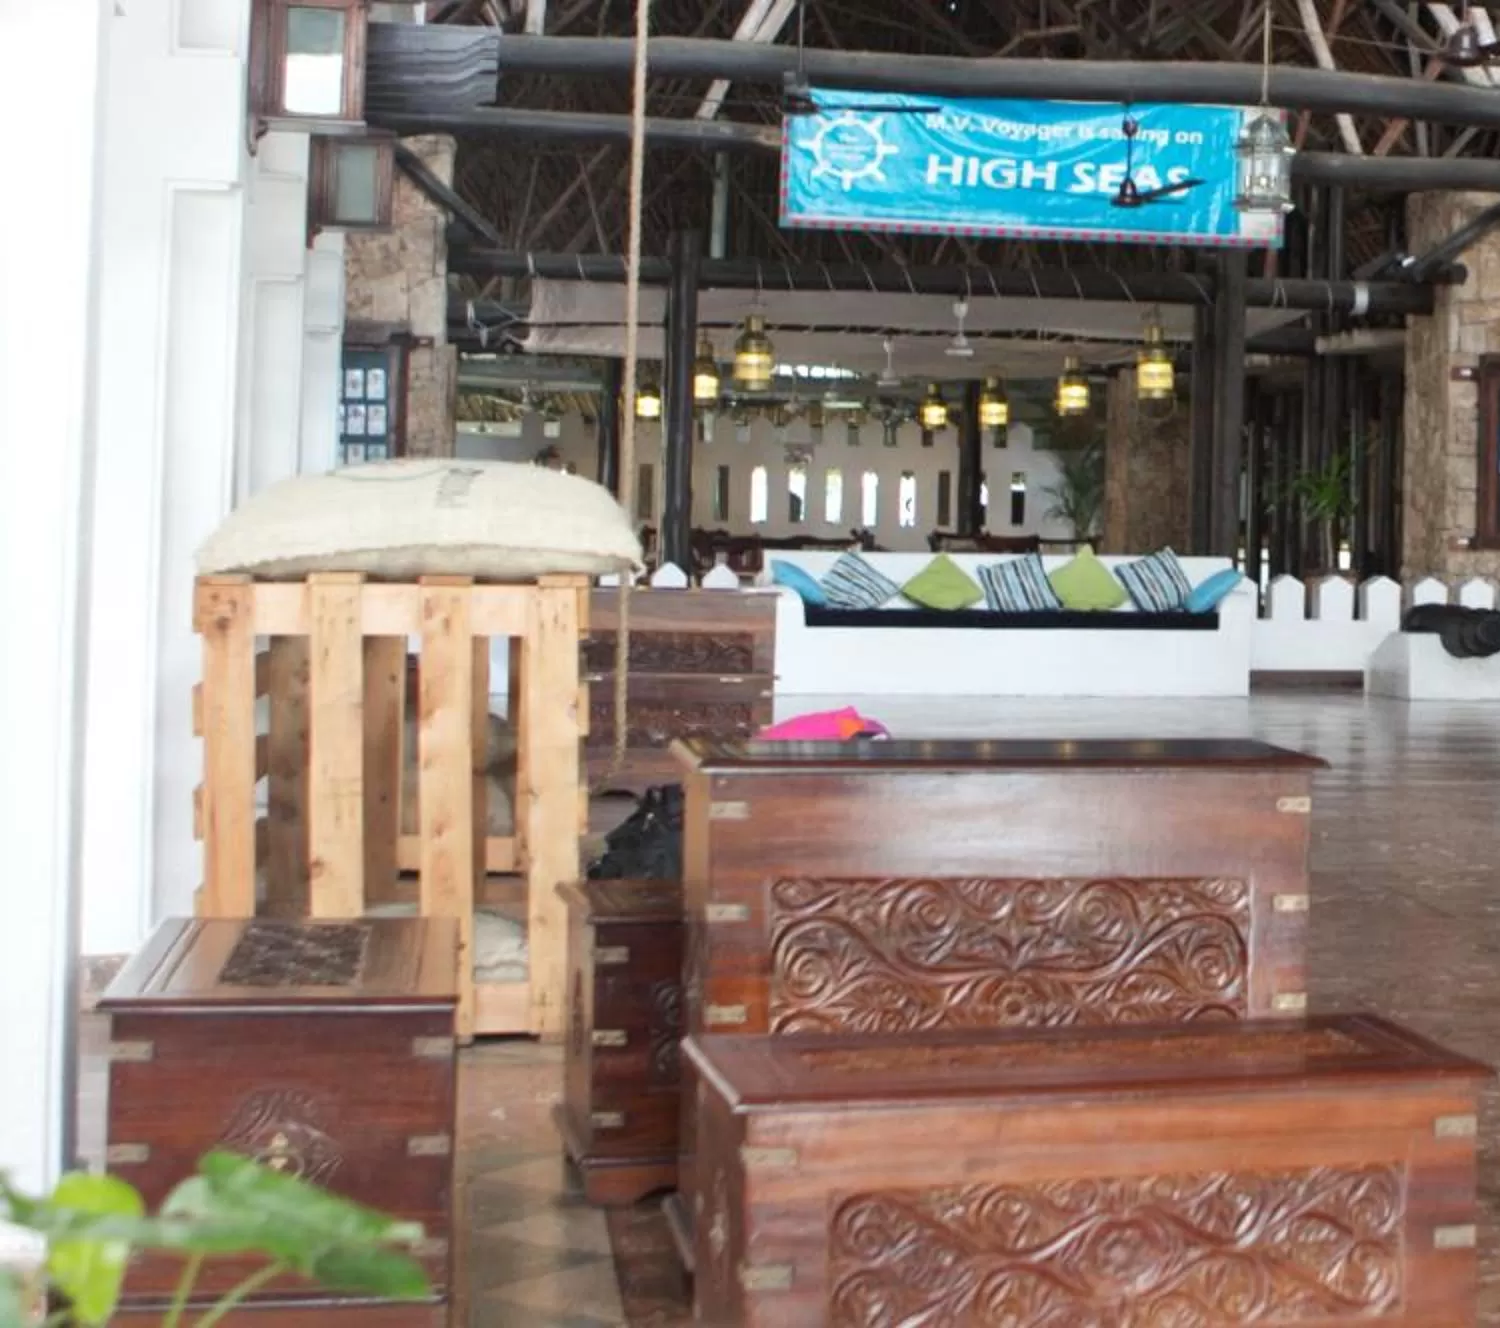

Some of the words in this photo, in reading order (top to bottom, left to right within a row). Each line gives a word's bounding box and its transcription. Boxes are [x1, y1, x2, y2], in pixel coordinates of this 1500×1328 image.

[926, 113, 974, 134] M.V.
[983, 118, 1071, 142] Voyager
[1078, 124, 1094, 139] is
[1099, 124, 1168, 148] saing
[1175, 130, 1203, 145] on
[926, 153, 1058, 192] HIGH
[1069, 160, 1191, 198] SEAS
